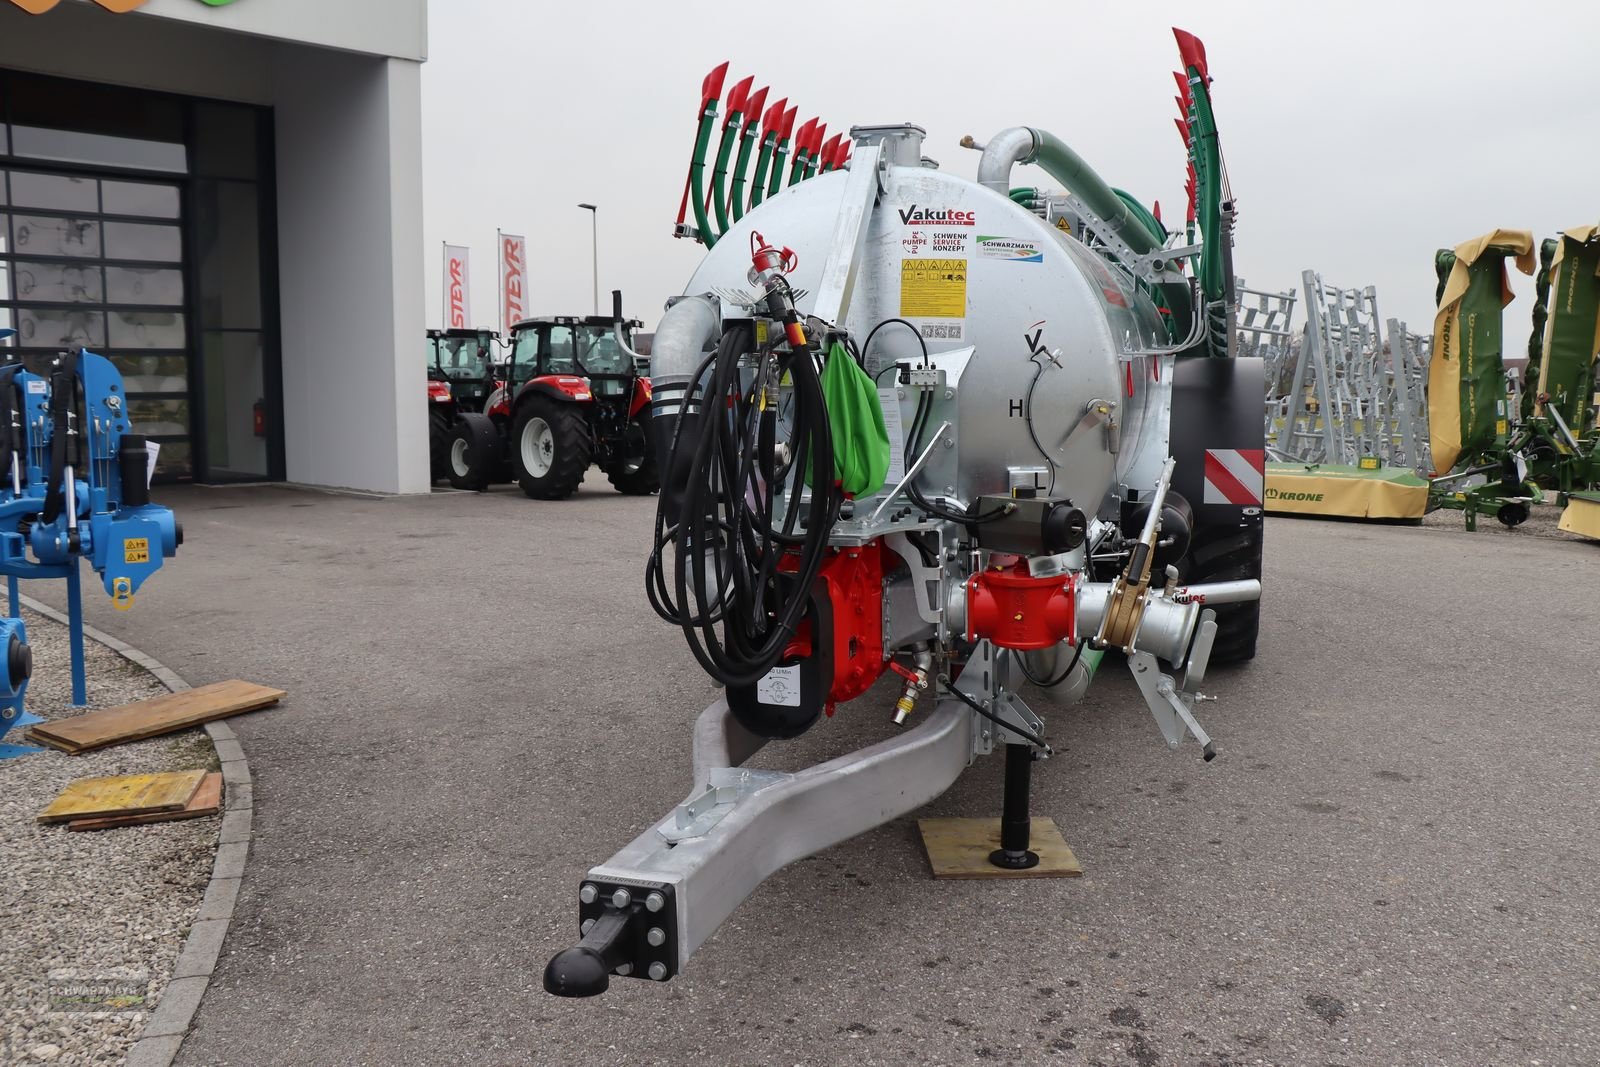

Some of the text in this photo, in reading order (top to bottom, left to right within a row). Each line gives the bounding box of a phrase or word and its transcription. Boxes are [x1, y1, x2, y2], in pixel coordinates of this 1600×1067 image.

[898, 204, 976, 225] Vakutec
[982, 241, 1034, 249] SCHWARZMAYR
[449, 258, 464, 330] STEYR
[1566, 269, 1576, 315] KRONE
[1009, 399, 1023, 417] H
[1279, 491, 1324, 502] KRONE
